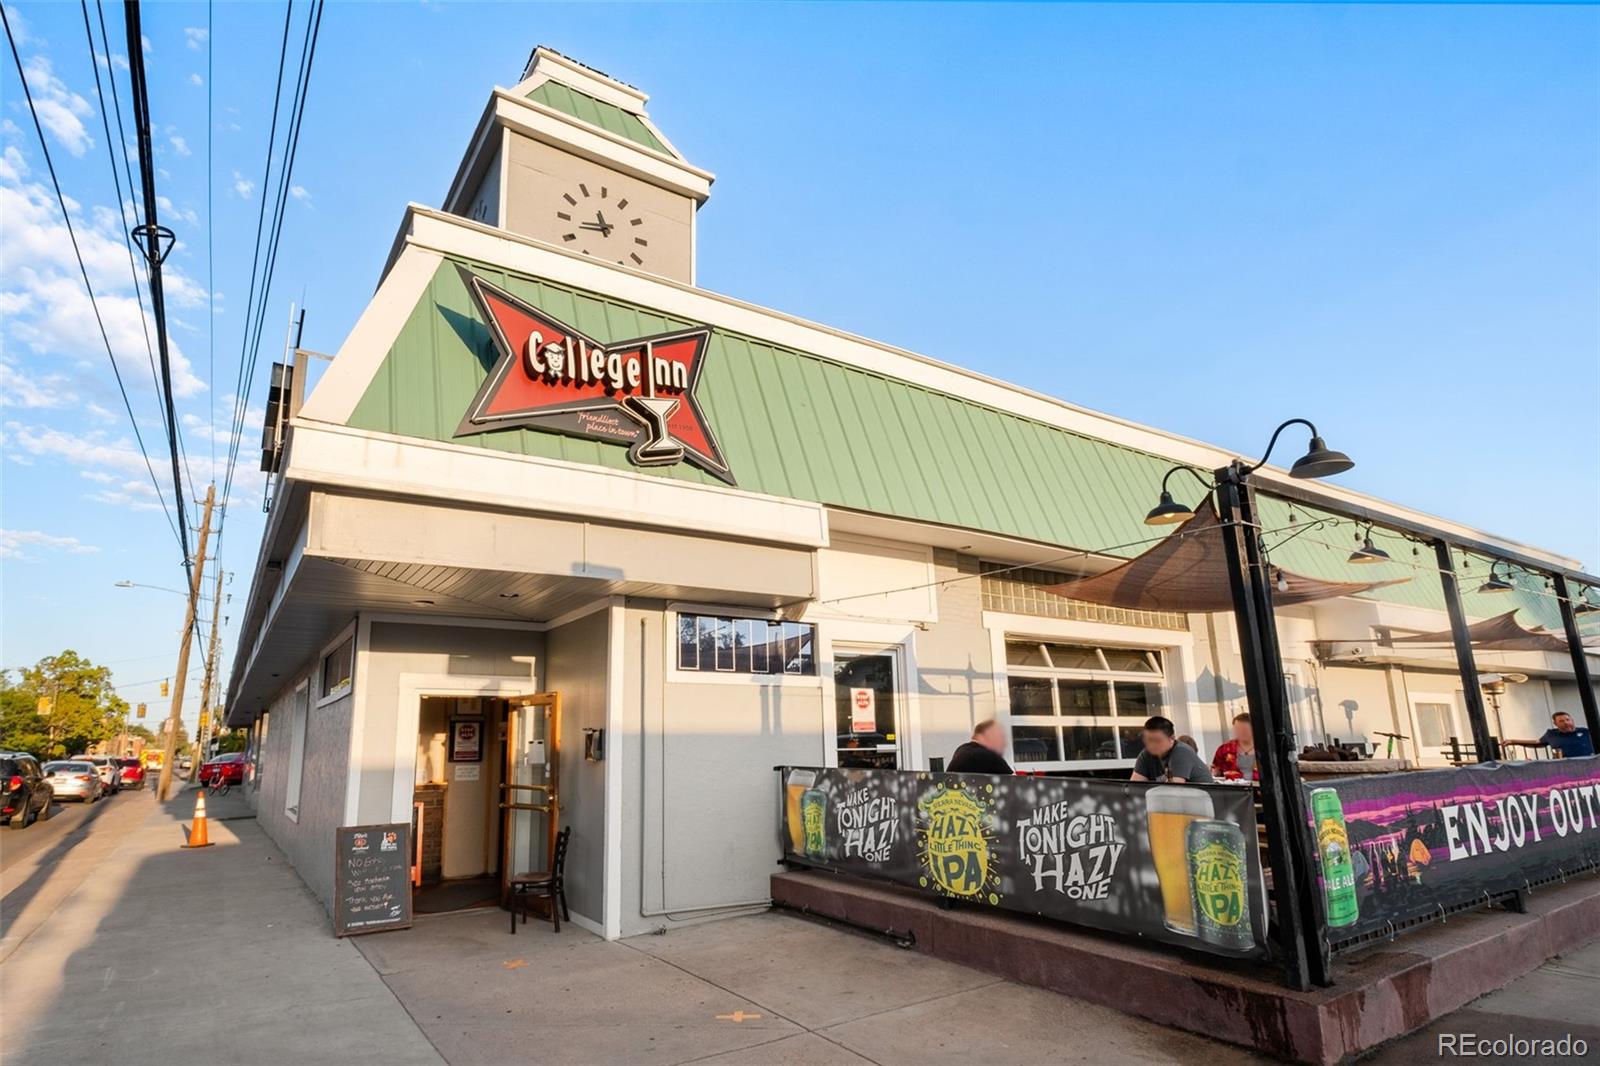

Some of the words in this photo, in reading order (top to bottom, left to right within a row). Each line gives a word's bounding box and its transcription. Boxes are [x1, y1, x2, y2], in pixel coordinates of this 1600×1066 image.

[647, 342, 688, 398] Inn
[846, 787, 870, 807] MAKE
[836, 796, 899, 833] TONIGHT
[931, 815, 978, 839] HAZY
[1033, 801, 1067, 825] MAKE
[1440, 793, 1542, 862] ENJOY
[844, 819, 900, 858] HAZY
[929, 840, 953, 853] LITTLE
[955, 840, 982, 851] THING
[1017, 814, 1116, 860] TONIGHT
[865, 845, 892, 862] ONE
[1025, 853, 1032, 866] A
[1030, 842, 1127, 895] HAZY
[931, 851, 982, 891] IPA
[1199, 863, 1239, 881] HAZY
[1066, 878, 1111, 900] ONE
[1199, 891, 1240, 922] IPA
